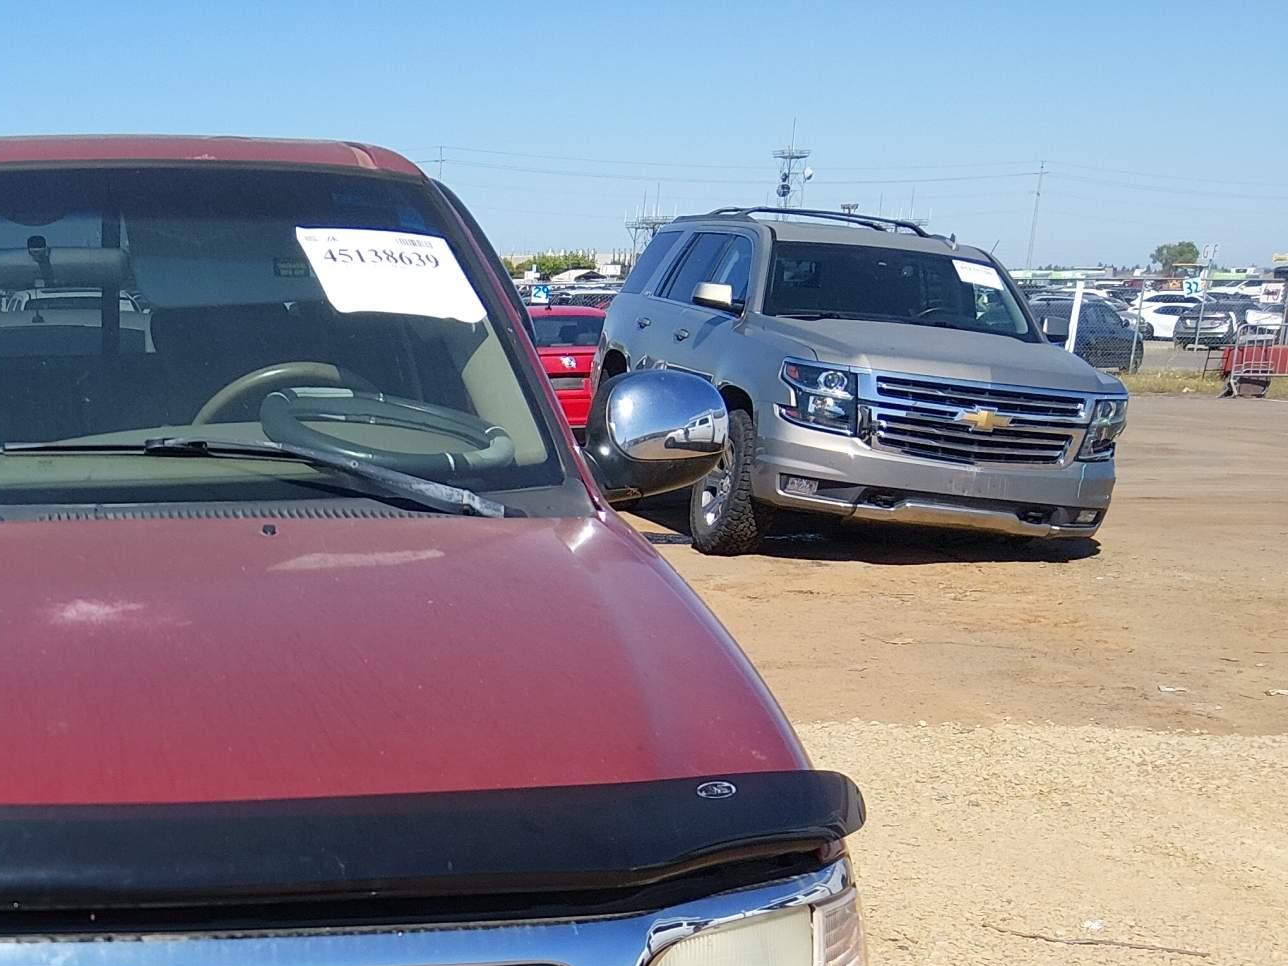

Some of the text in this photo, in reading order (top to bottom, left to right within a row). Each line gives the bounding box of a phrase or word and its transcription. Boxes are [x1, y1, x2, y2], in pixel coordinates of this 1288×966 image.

[323, 248, 440, 268] 45138639
[533, 284, 550, 299] 29
[1184, 280, 1202, 296] 32
